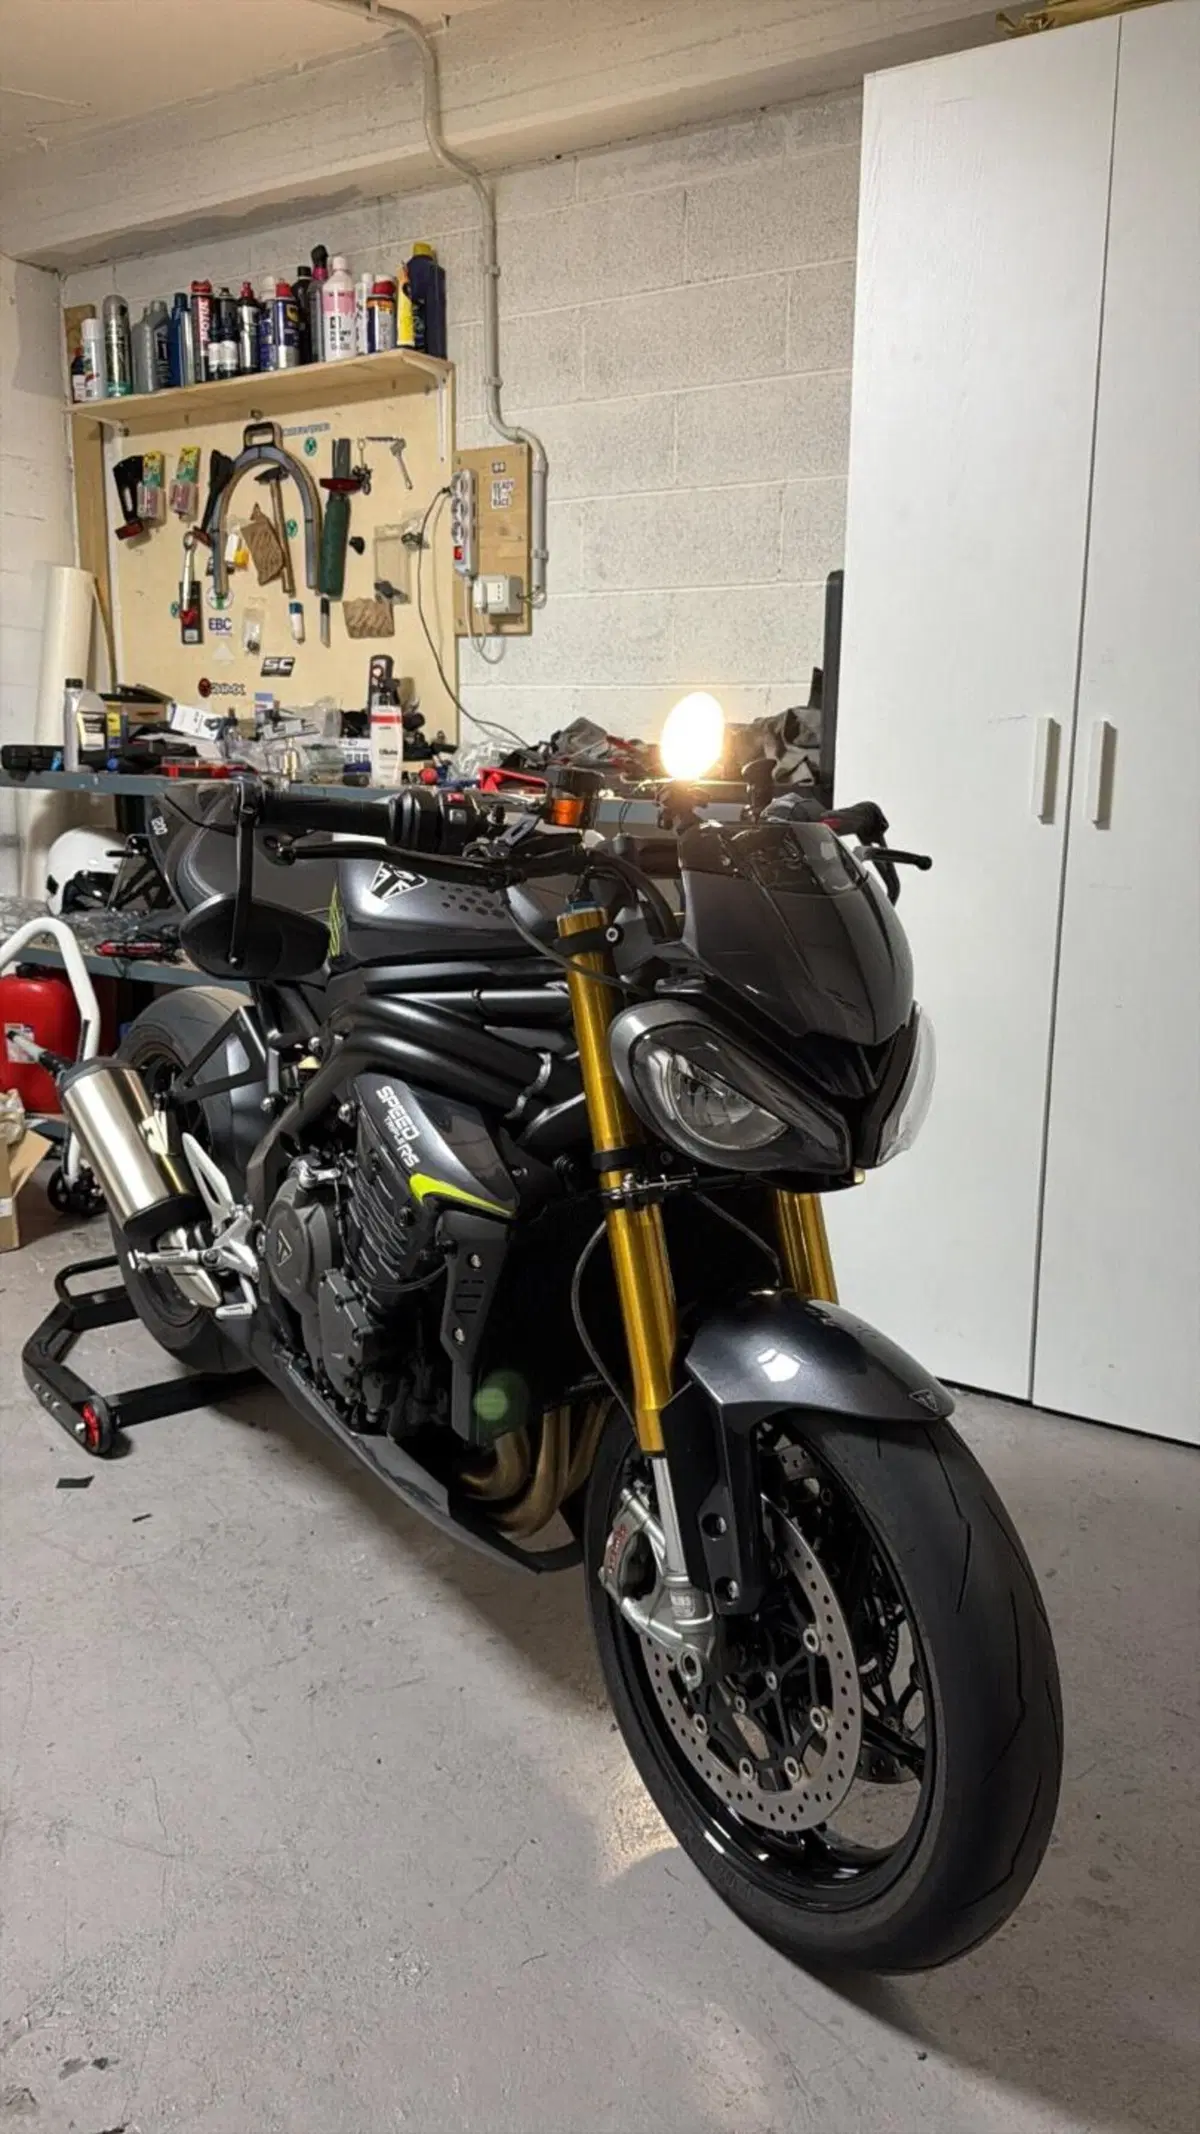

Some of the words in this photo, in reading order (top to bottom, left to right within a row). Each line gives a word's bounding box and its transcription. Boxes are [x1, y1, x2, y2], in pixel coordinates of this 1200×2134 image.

[208, 617, 232, 631] EBC
[263, 658, 294, 670] SC
[376, 1085, 420, 1140] SPEED
[397, 1143, 421, 1168] RS
